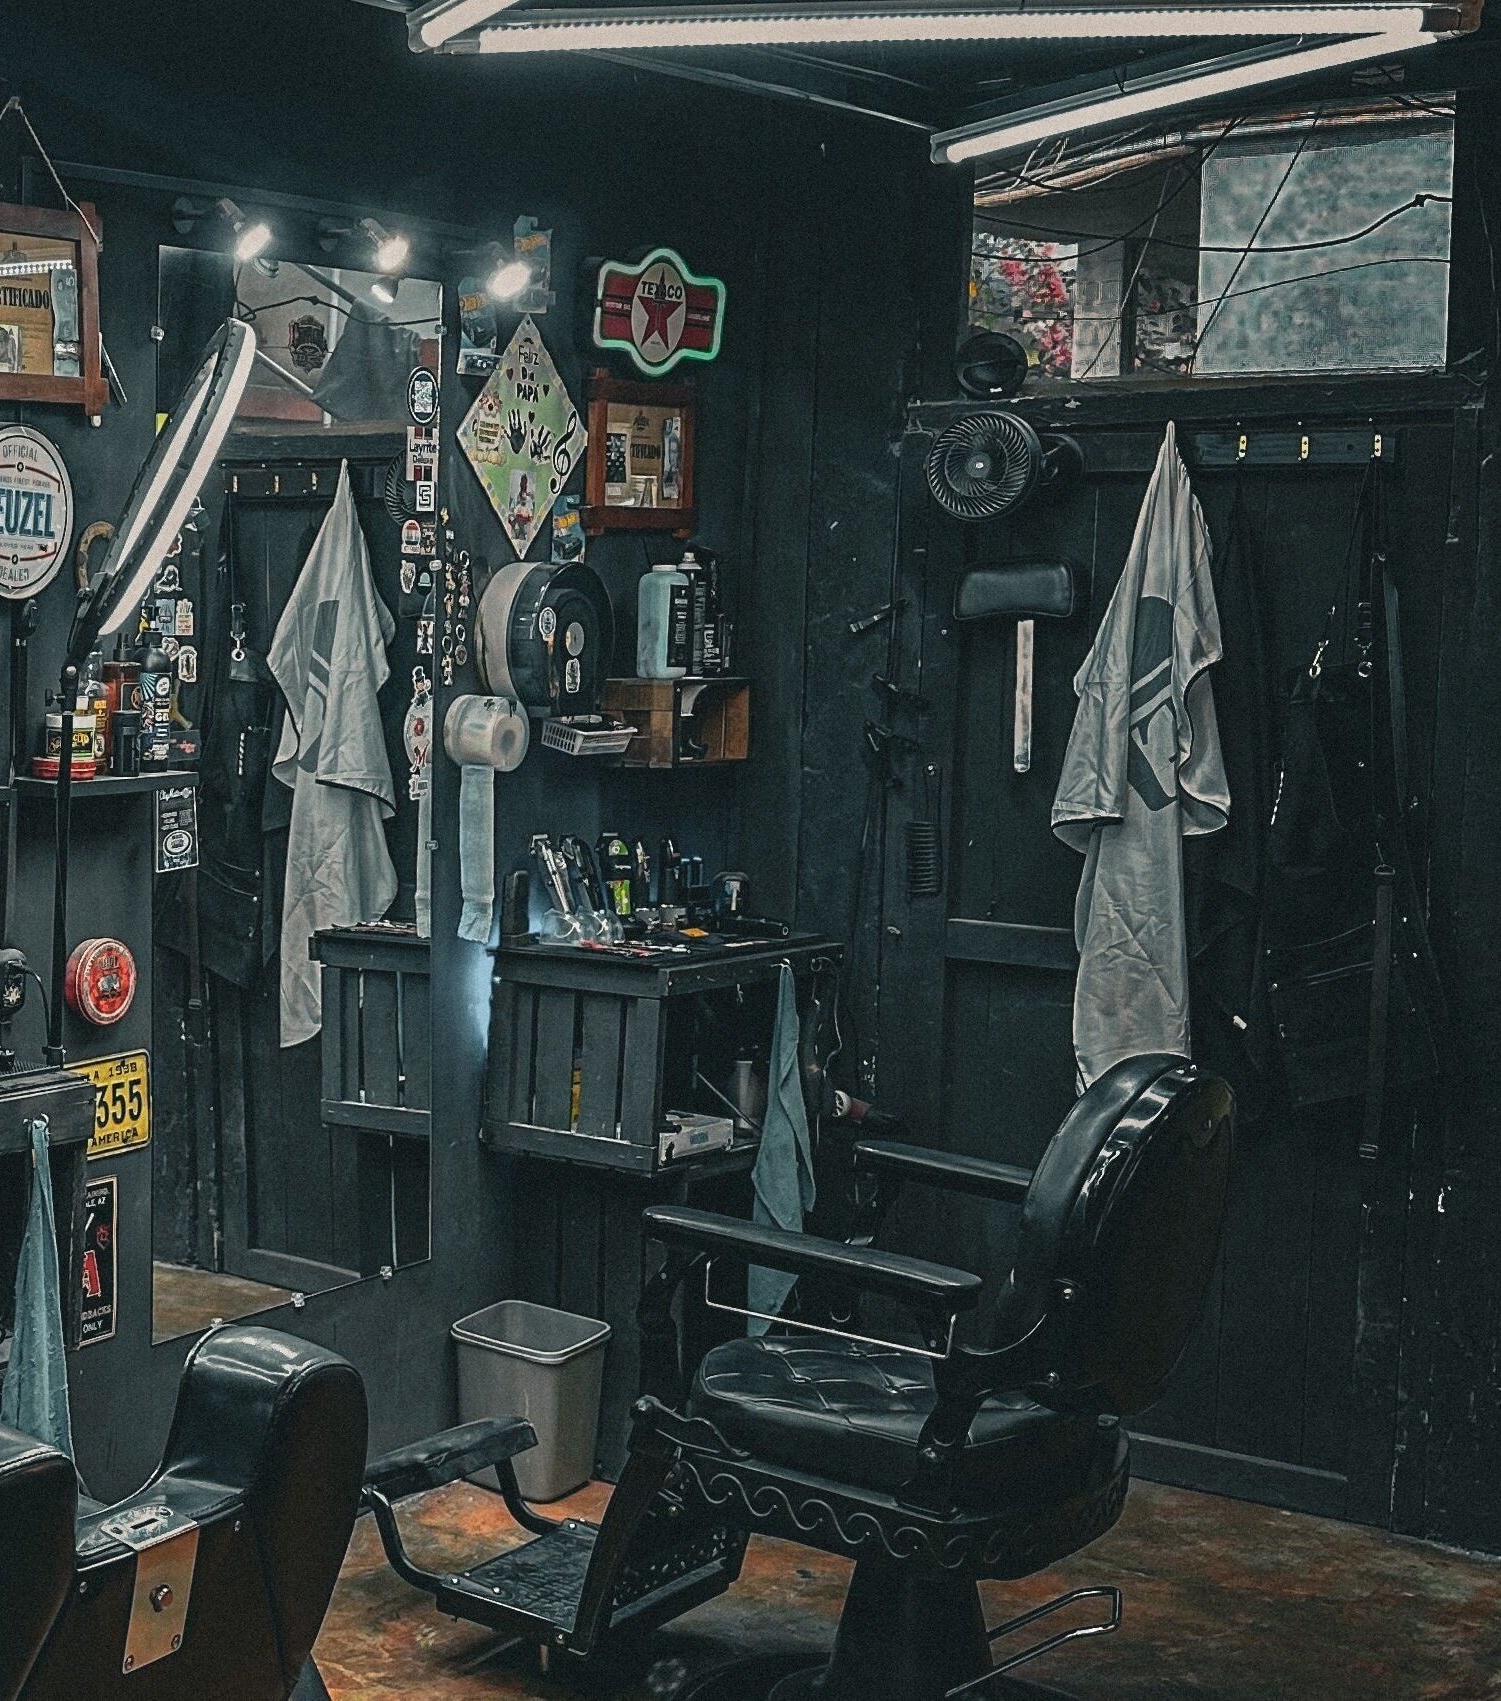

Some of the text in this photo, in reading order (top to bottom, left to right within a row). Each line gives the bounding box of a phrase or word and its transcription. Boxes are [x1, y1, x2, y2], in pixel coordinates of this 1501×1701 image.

[641, 280, 683, 300] TEXACO
[519, 344, 540, 365] Feliz
[2, 444, 40, 463] OFFICIAL
[409, 438, 438, 457] Layrite
[91, 1127, 139, 1148] AMERICA
[82, 1319, 104, 1335] ONLY
